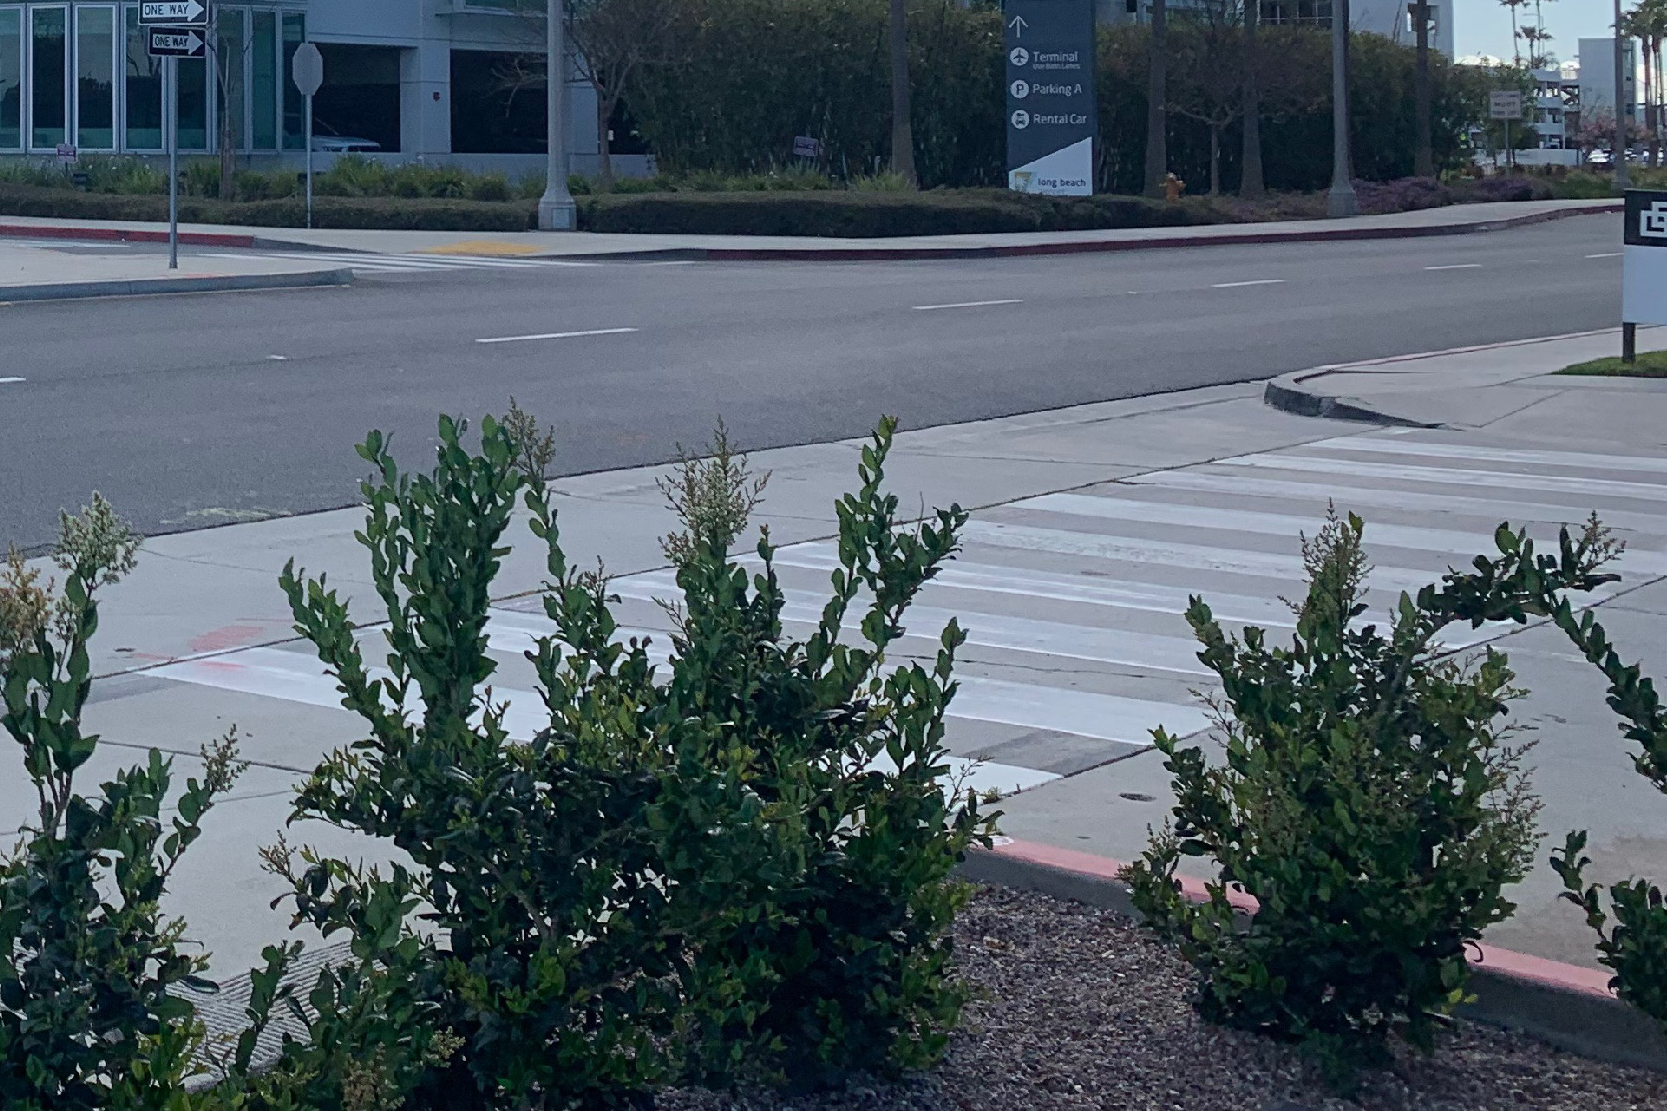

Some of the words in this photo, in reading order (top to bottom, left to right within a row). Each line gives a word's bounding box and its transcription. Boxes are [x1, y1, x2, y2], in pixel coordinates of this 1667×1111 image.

[145, 5, 164, 15] ONE
[170, 4, 189, 15] WAY
[155, 36, 171, 47] ONE
[173, 37, 189, 47] WAY
[1033, 51, 1078, 62] Terminal
[1033, 83, 1072, 97] Parking
[1074, 83, 1082, 93] A
[1033, 113, 1069, 124] Rental
[1070, 114, 1087, 124] Car
[1038, 178, 1057, 188] long
[1060, 178, 1086, 187] beach
